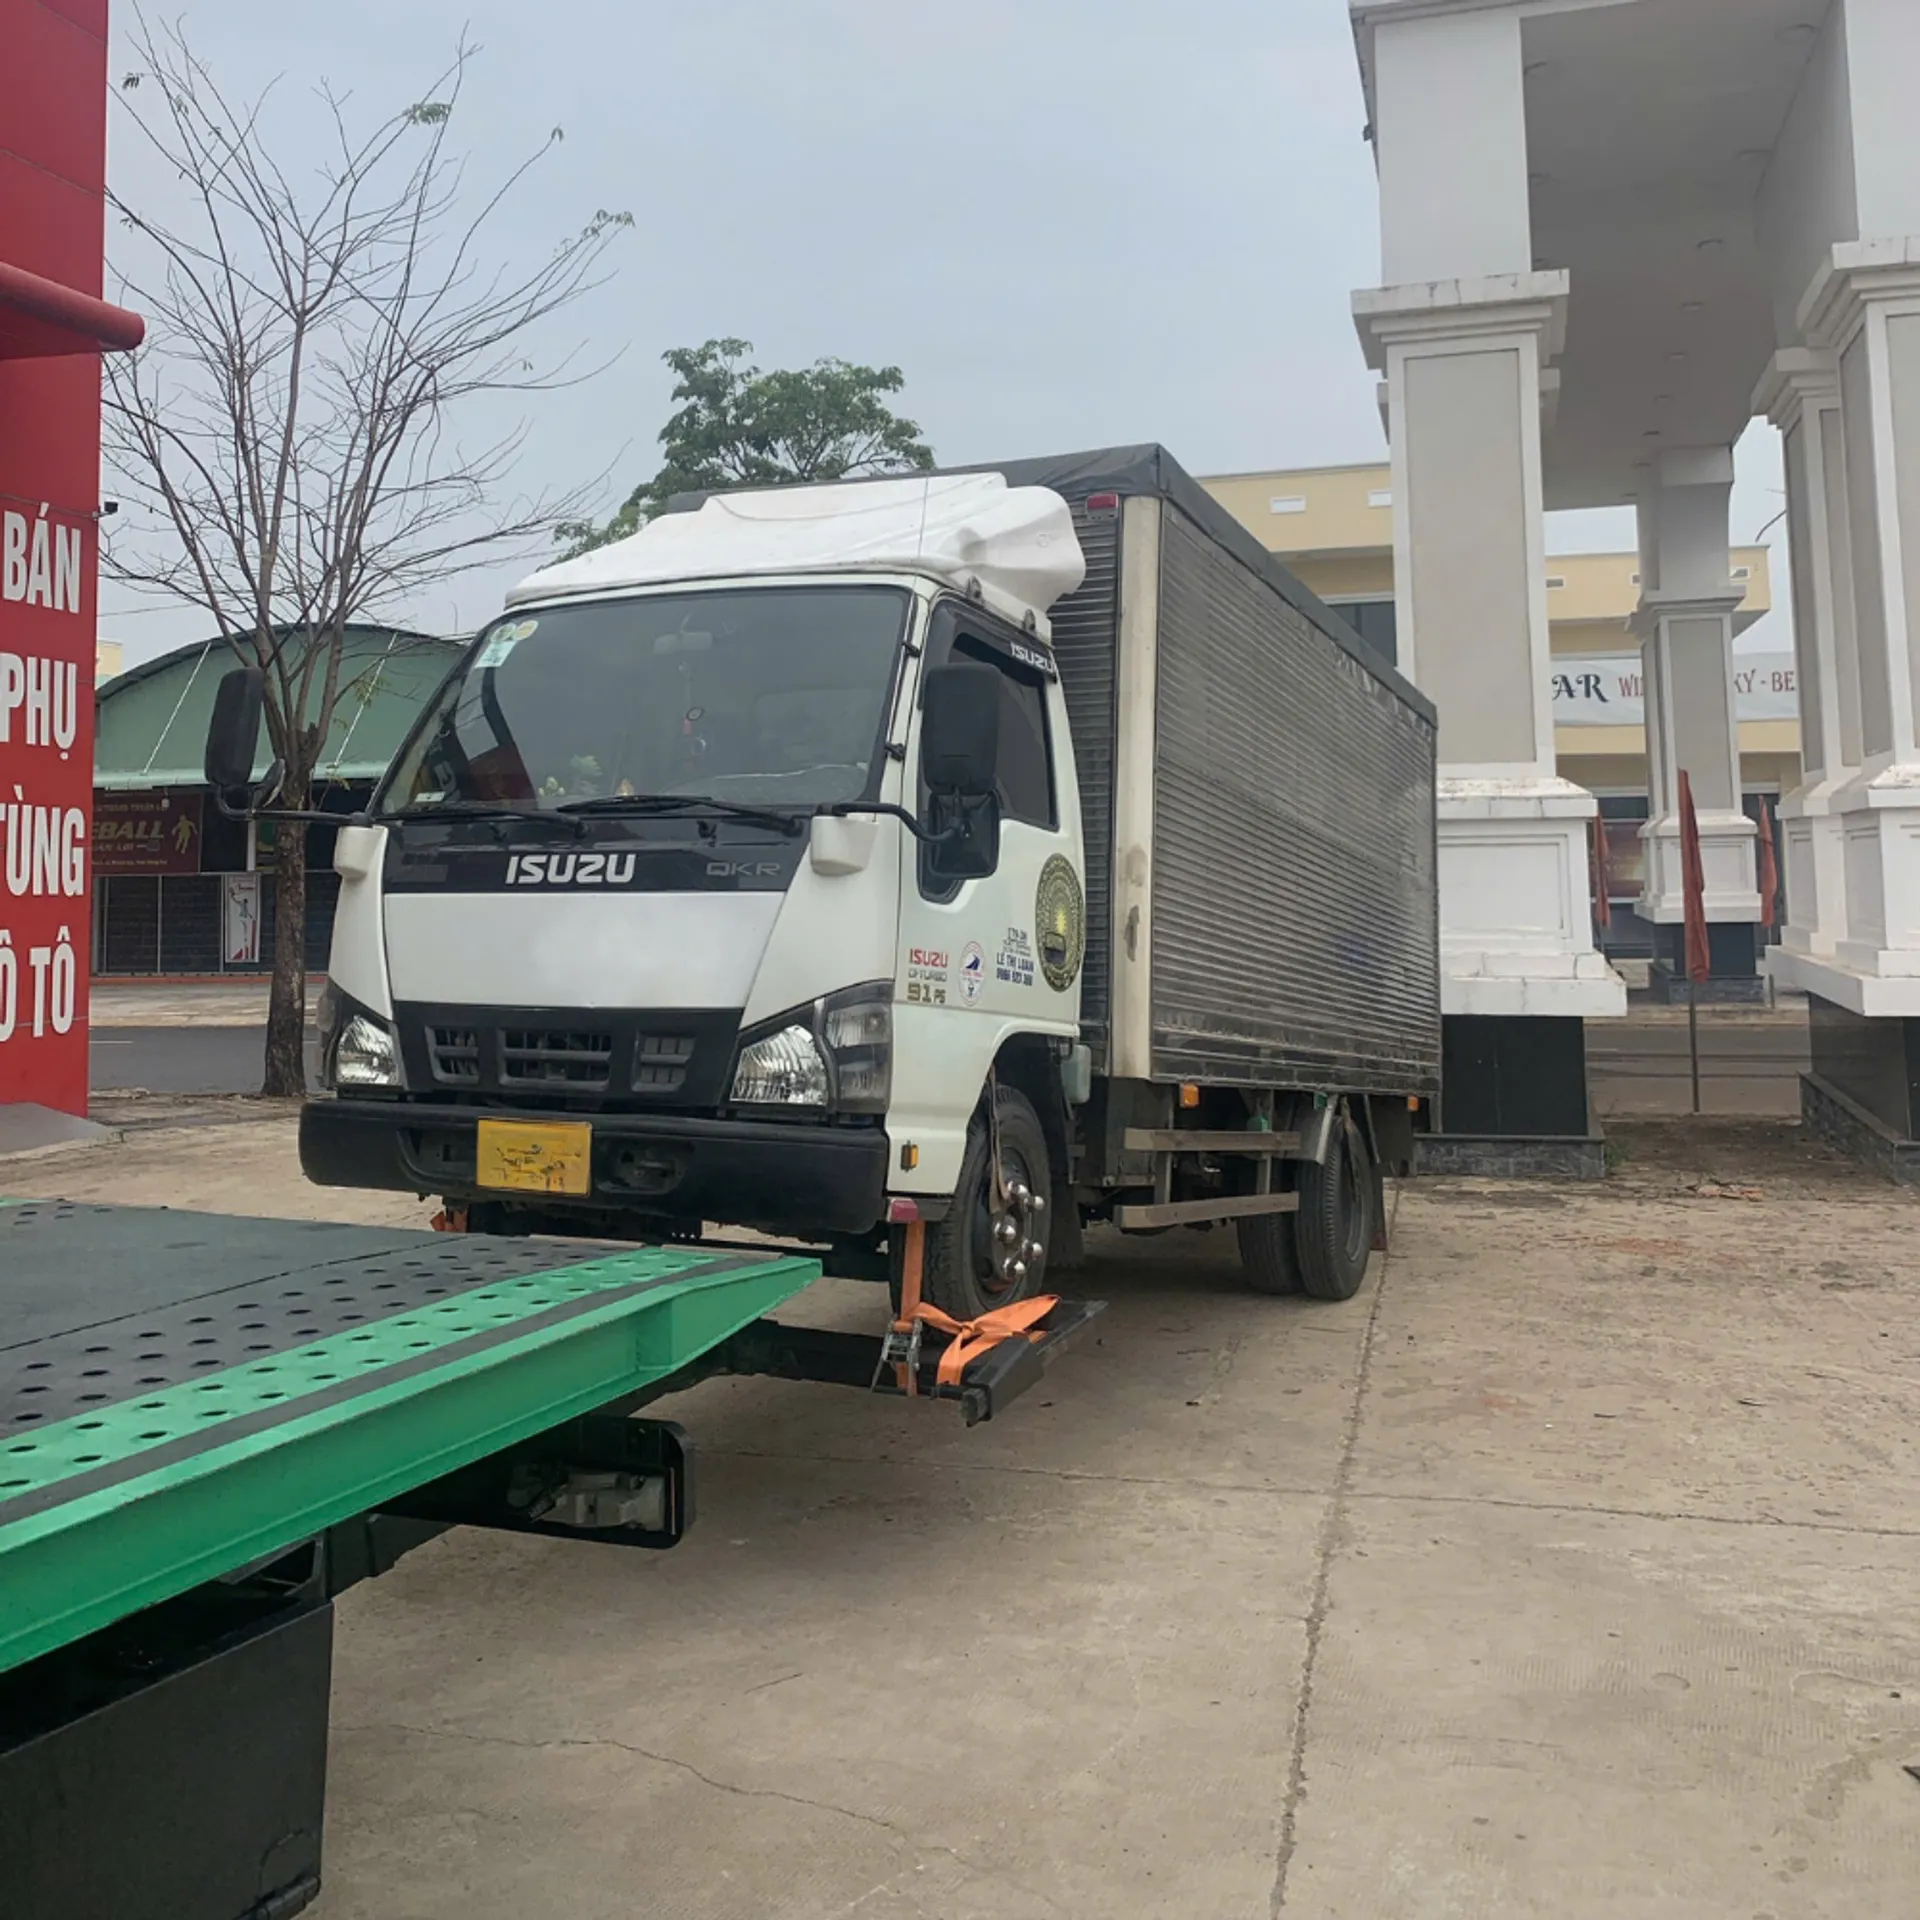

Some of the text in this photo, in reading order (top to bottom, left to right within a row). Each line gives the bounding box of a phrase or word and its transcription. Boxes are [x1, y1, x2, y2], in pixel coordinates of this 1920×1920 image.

[3, 502, 81, 614] BÁN
[1010, 641, 1056, 674] ISUZU
[0, 652, 77, 760] PHỤ
[505, 853, 636, 885] ISUZU
[705, 862, 781, 877] QKR
[909, 948, 949, 970] ISUZU
[29, 926, 75, 1038] TÔ
